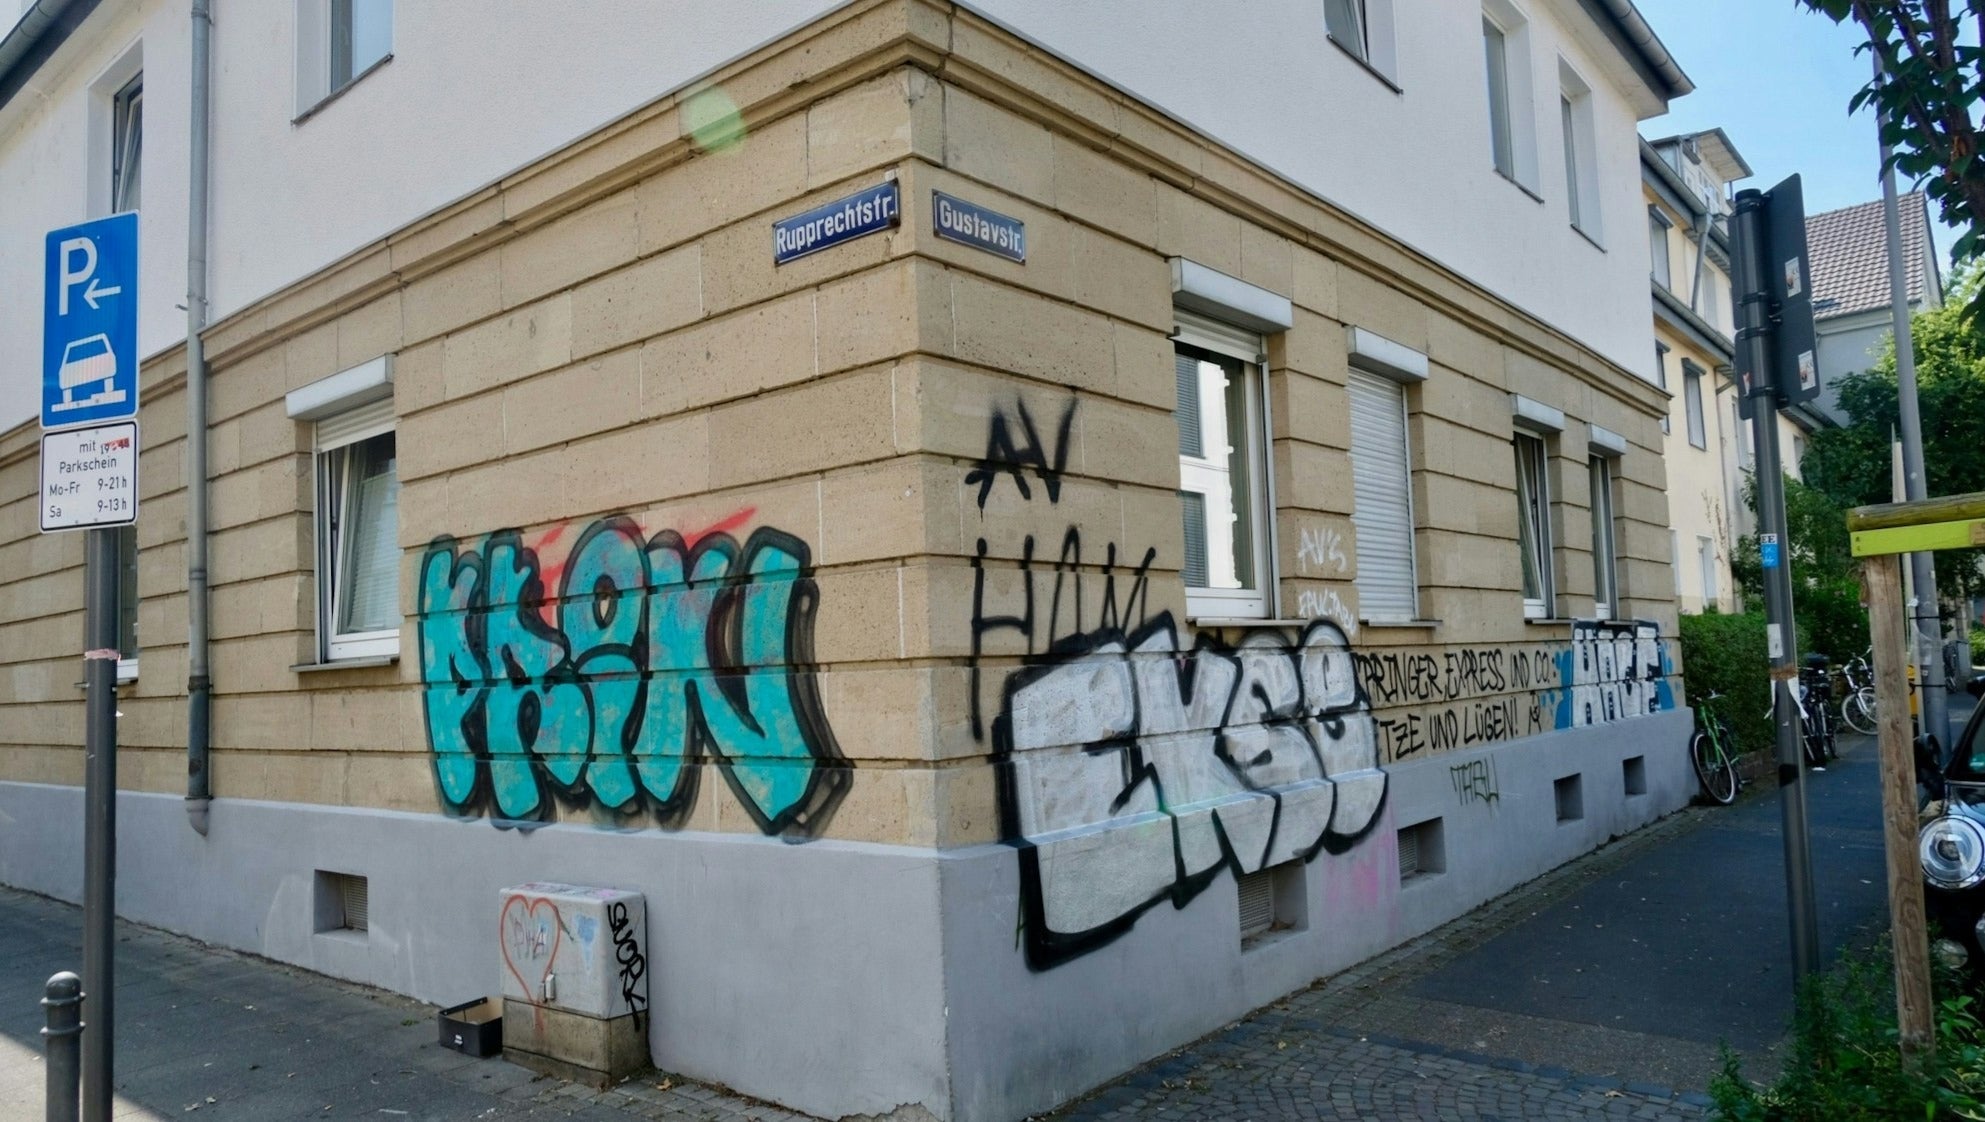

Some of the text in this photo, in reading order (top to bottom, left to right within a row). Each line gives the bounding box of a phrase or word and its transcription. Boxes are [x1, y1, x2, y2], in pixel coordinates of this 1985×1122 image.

[775, 193, 895, 255] Rupprechtstr.
[938, 200, 1023, 254] Gustavstr.
[58, 236, 98, 316] P
[59, 457, 117, 474] Parkschein
[79, 440, 96, 454] mit
[49, 475, 127, 497] Mo-Fr 9-21 h
[49, 497, 127, 518] Sa 9-13 h
[1445, 648, 1506, 699] EXPRESS
[1511, 649, 1530, 689] UND
[1373, 696, 1519, 764] TZE UND LÜGEN!
